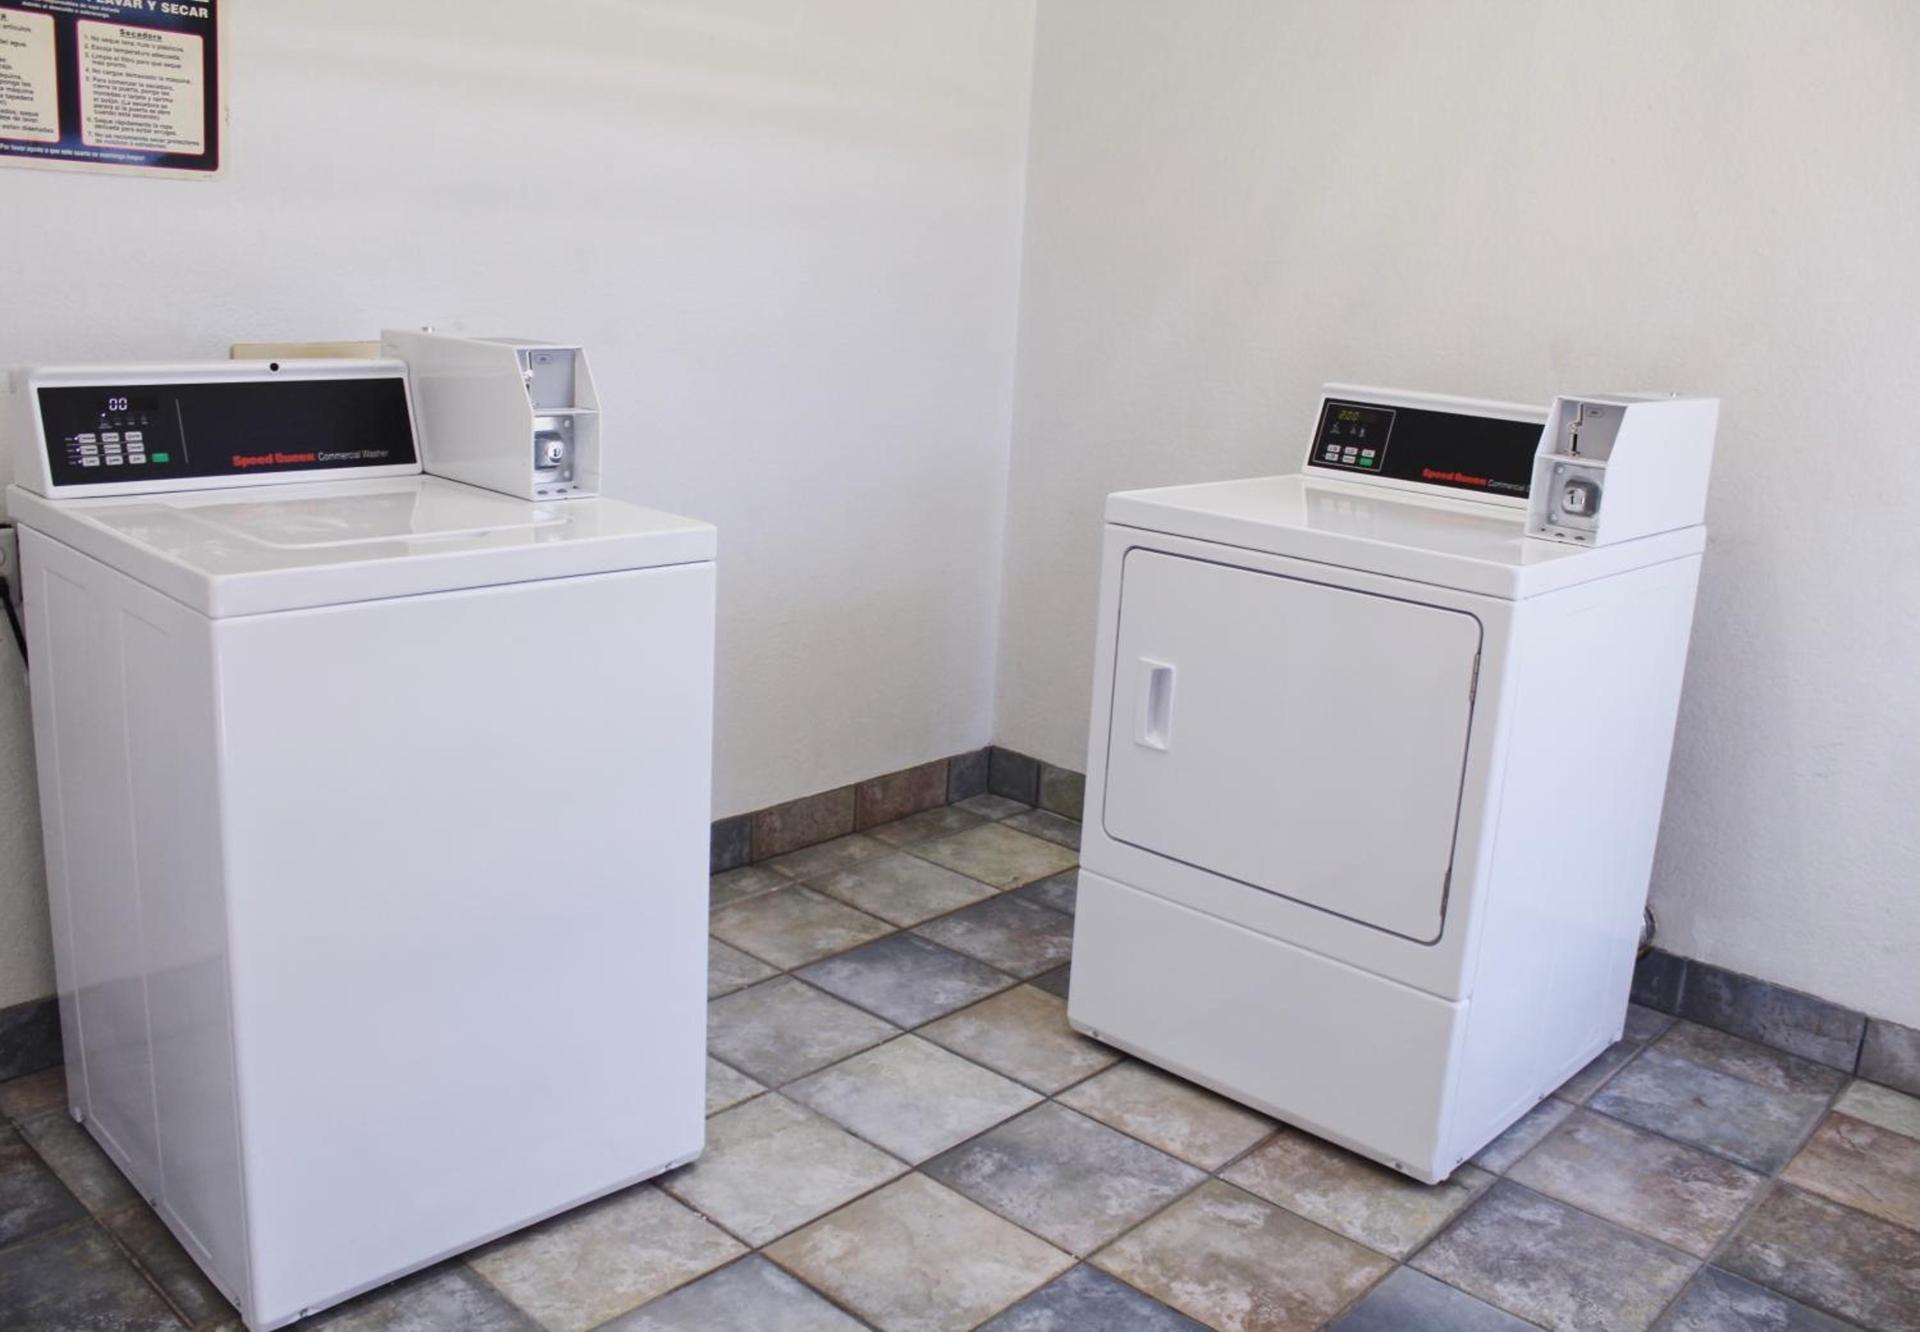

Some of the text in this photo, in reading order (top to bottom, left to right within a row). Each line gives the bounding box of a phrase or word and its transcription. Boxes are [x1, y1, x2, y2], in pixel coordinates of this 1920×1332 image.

[147, 1, 156, 10] Y
[161, 3, 208, 18] SECAR
[120, 28, 162, 40] Secadora
[232, 449, 389, 468] Speed Queen Commercial Washer
[1423, 467, 1454, 480] Speed
